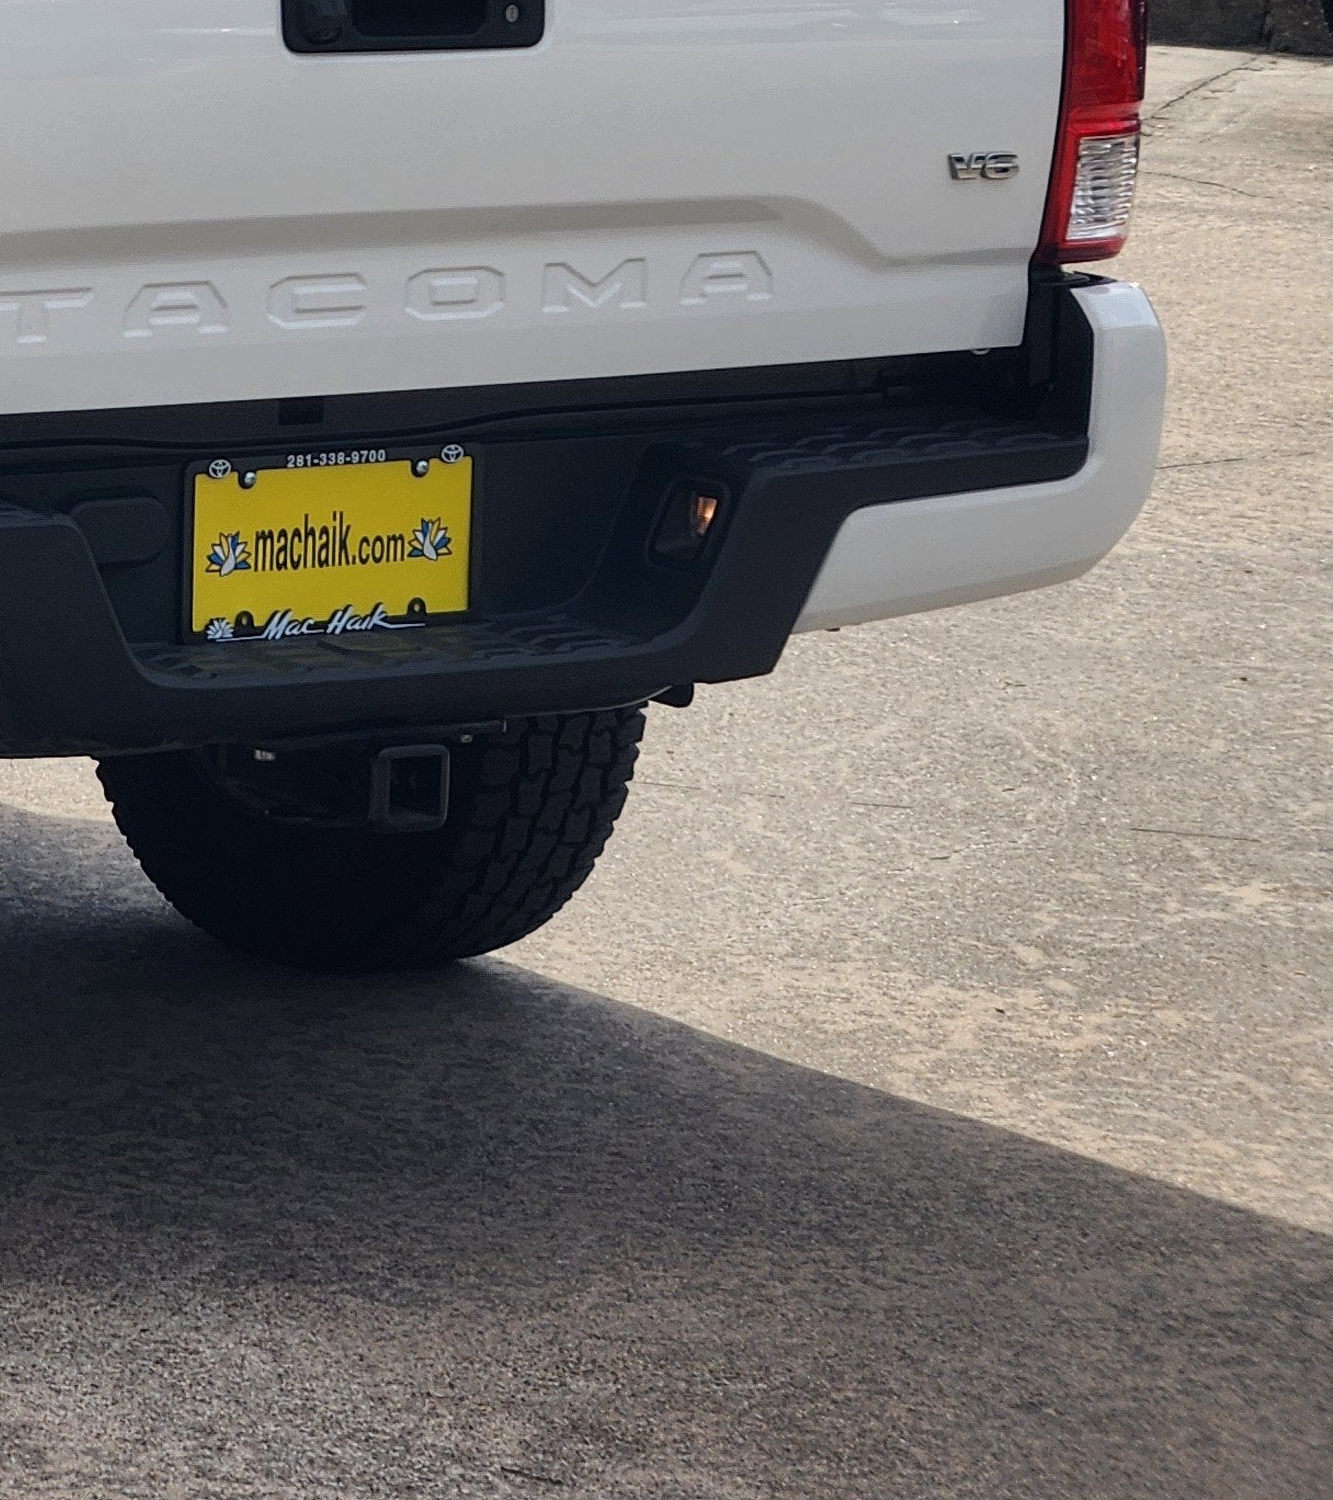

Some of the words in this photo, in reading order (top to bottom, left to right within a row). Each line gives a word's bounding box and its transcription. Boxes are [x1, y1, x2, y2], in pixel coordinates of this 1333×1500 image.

[947, 150, 1020, 181] V6
[286, 449, 386, 468] 281-338-9700
[253, 510, 406, 573] machaik.com
[255, 609, 324, 641] Mac
[325, 601, 406, 635] Haik
